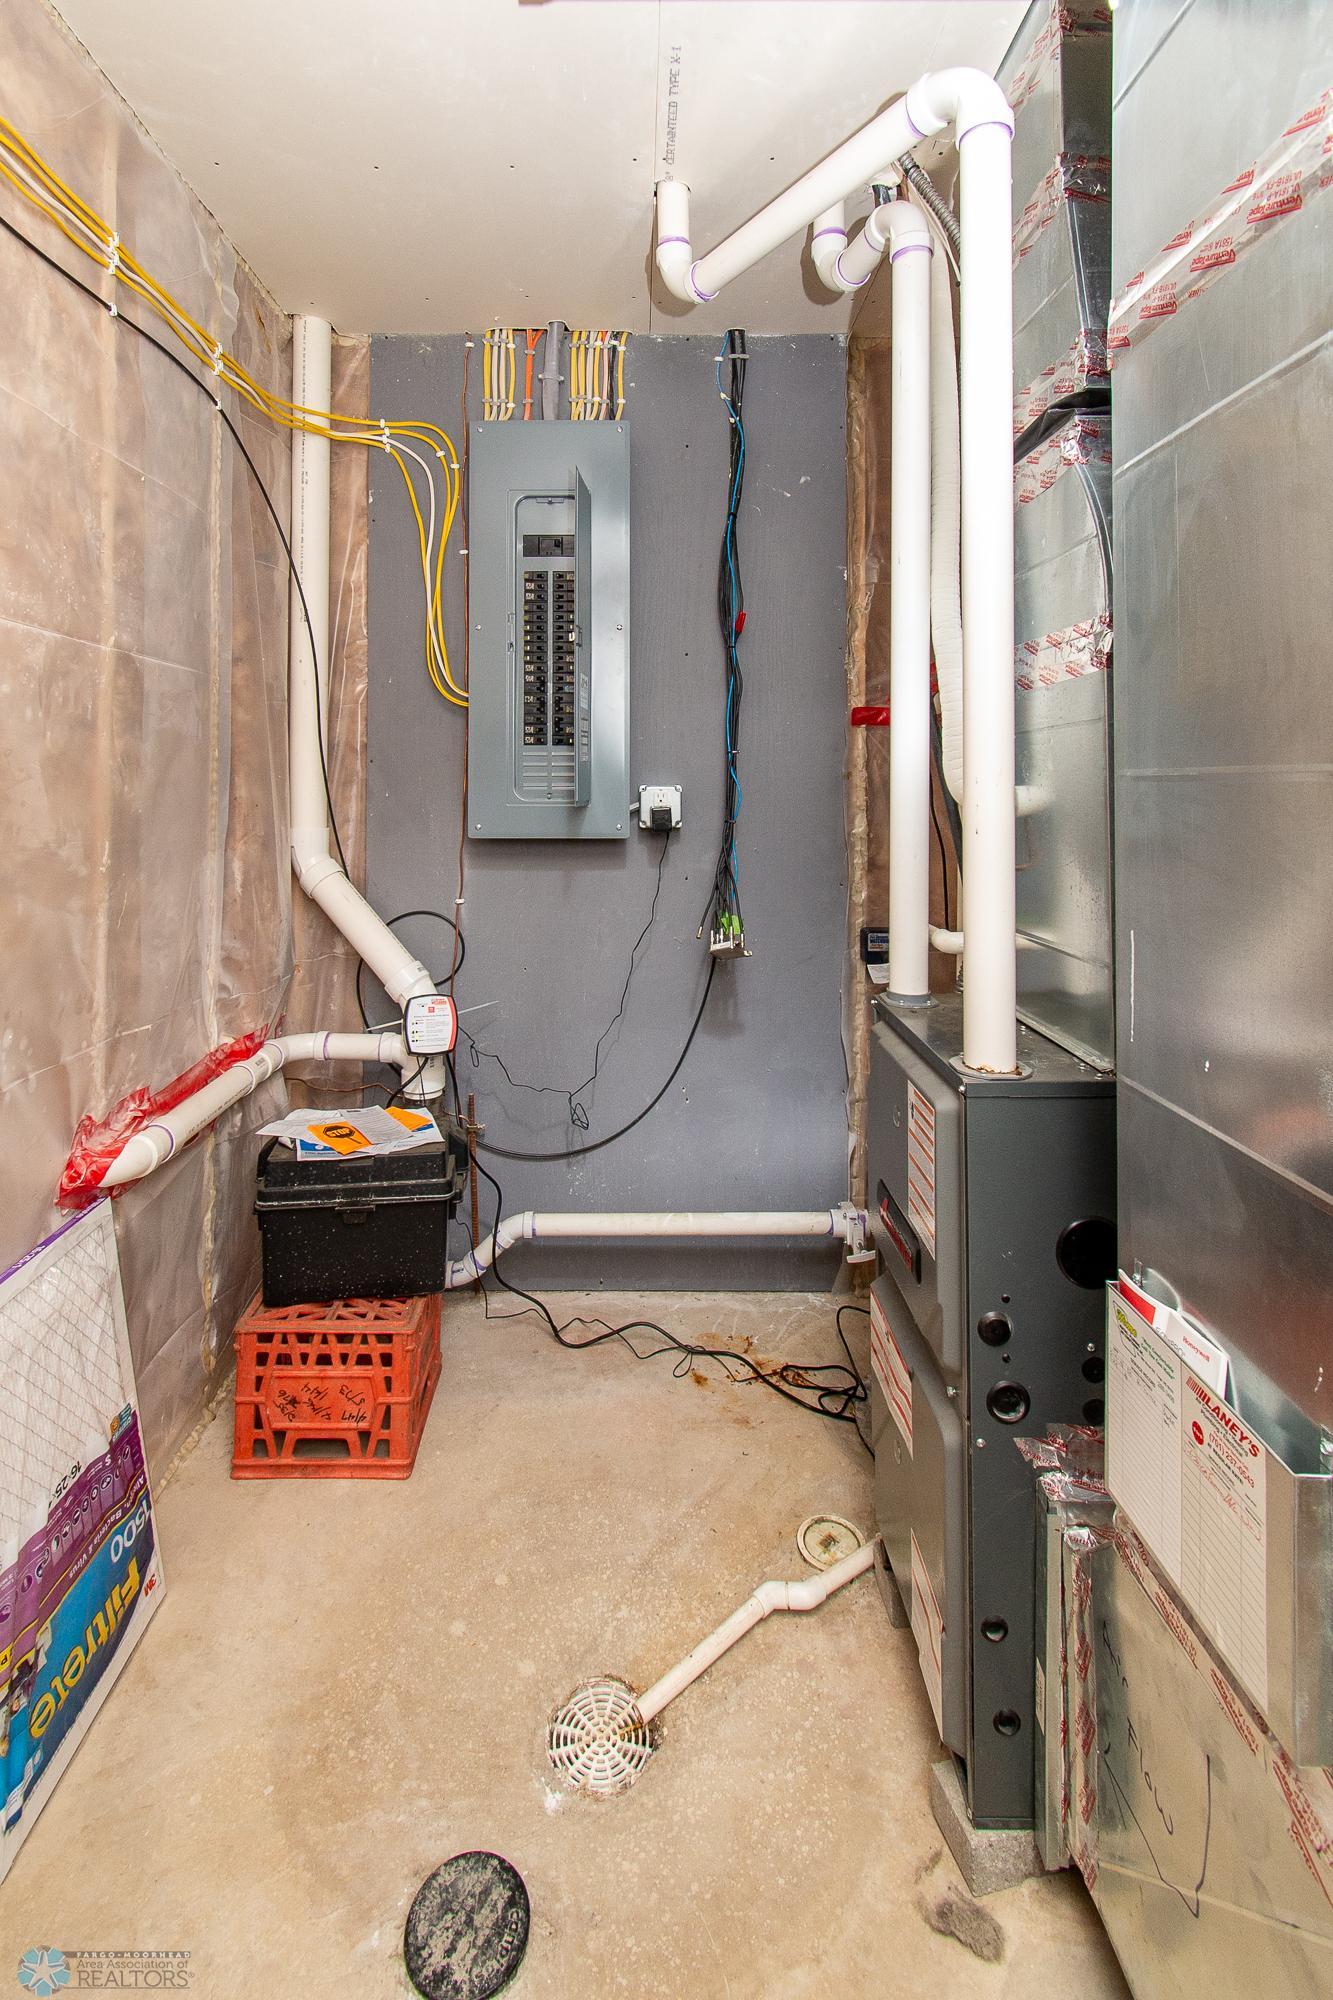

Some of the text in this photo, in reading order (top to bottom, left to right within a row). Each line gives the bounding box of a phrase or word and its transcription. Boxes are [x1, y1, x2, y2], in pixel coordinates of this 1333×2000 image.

[668, 68, 681, 96] TYPE
[326, 1126, 351, 1139] STOP
[1182, 1335, 1210, 1362] Honeywell
[1204, 1396, 1260, 1458] LANEY'S
[110, 1499, 151, 1564] 1500
[69, 1553, 88, 1578] Virus
[144, 1573, 157, 1597] 3M
[30, 1556, 140, 1739] Filtrete
